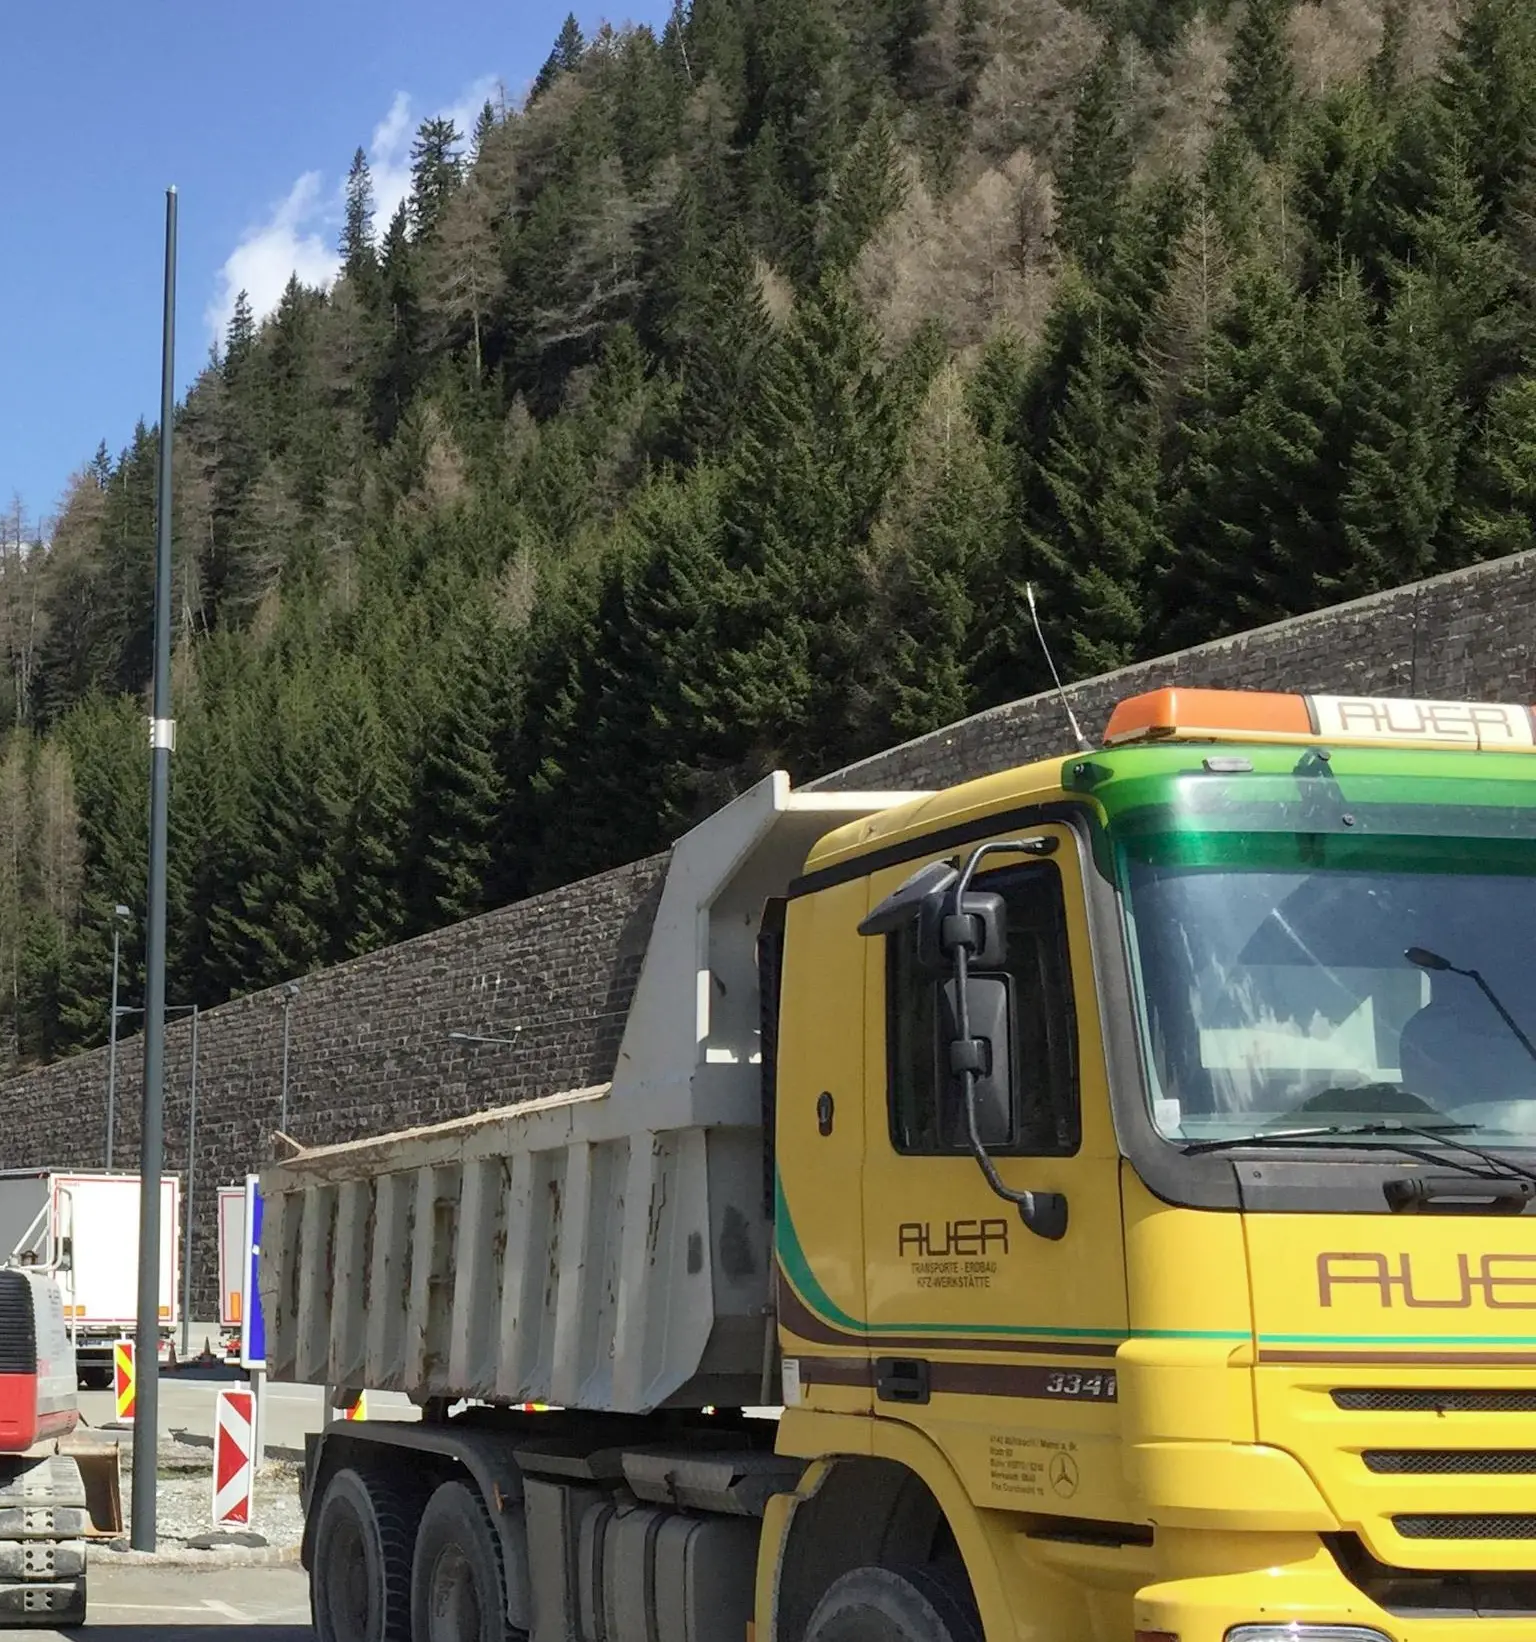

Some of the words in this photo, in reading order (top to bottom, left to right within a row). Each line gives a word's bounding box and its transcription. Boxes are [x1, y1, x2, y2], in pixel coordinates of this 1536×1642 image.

[1337, 701, 1514, 738] AUER
[898, 1218, 1009, 1257] AUER
[1046, 1371, 1115, 1396] 3341
